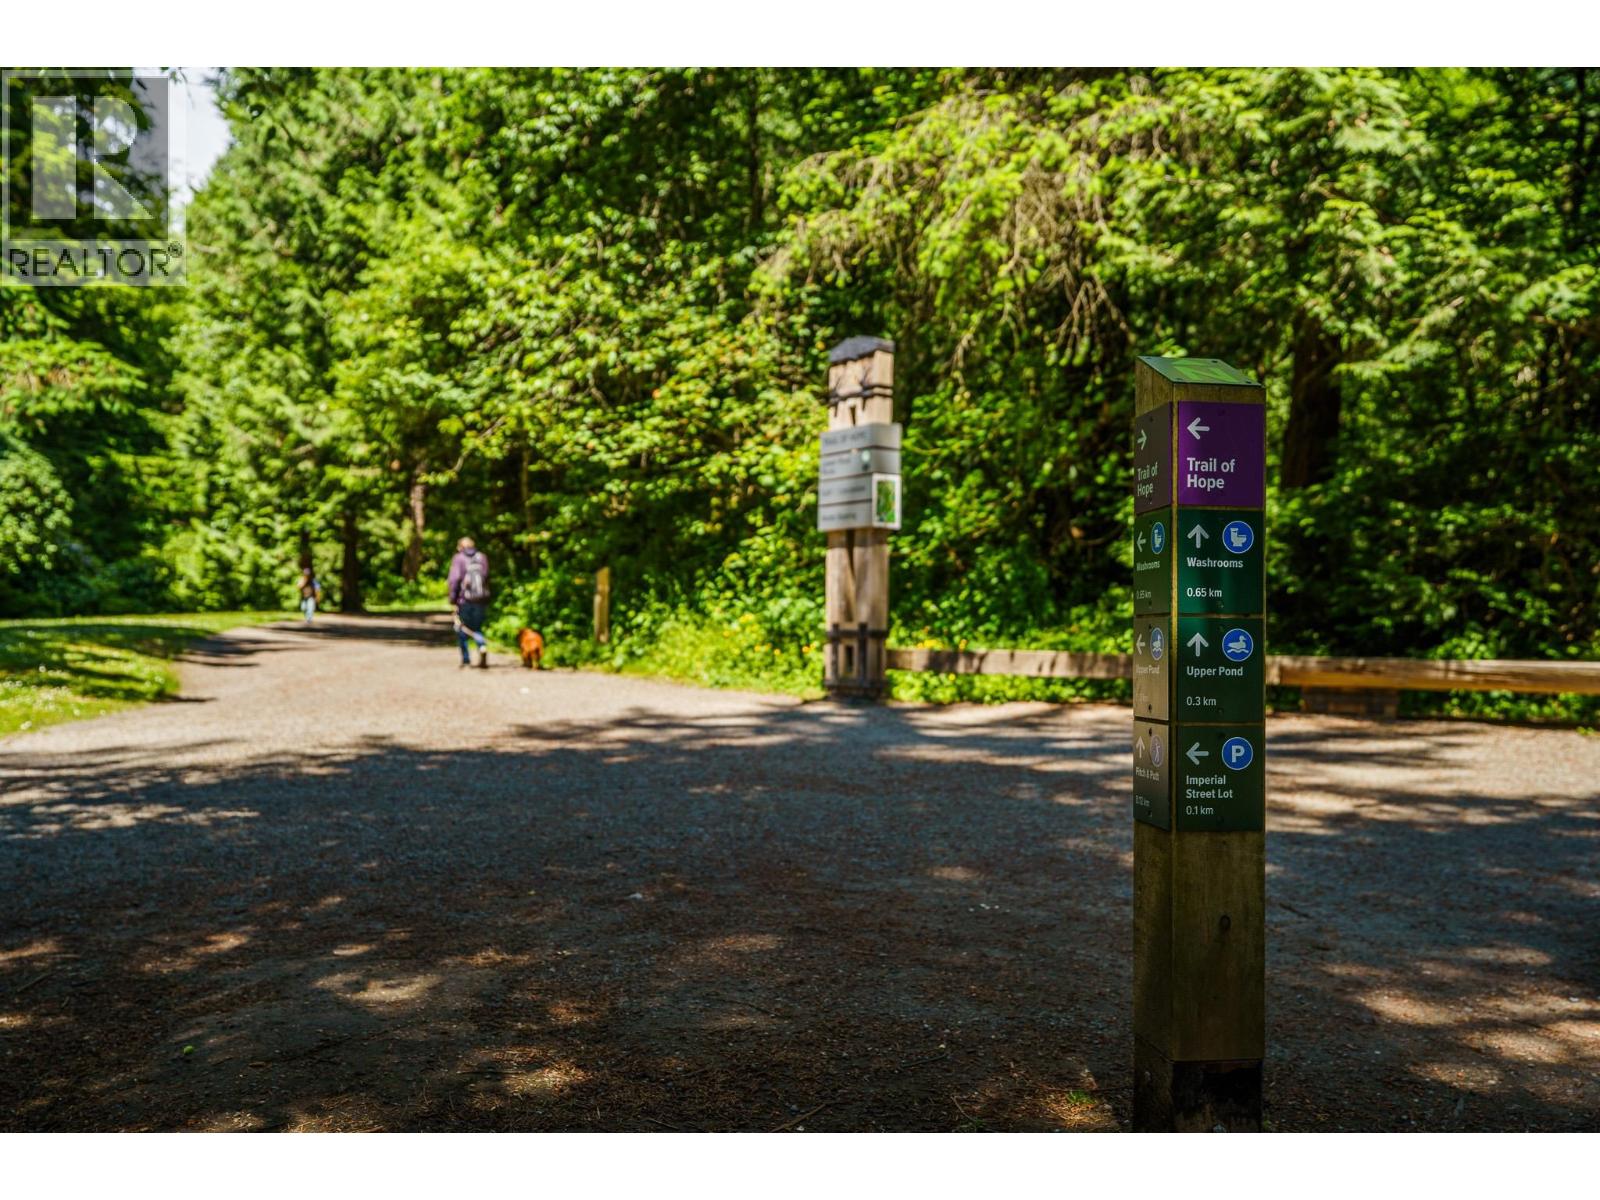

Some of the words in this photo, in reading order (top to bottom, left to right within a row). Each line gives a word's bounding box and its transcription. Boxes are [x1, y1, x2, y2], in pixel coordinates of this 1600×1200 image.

[1137, 464, 1150, 481] Trail
[1151, 461, 1158, 477] of
[1187, 457, 1217, 472] Trail
[1221, 459, 1236, 473] of
[1187, 474, 1225, 492] Hope
[1137, 482, 1154, 498] Hope
[1187, 557, 1244, 569] Washrooms
[1187, 587, 1207, 597] 0.65
[1209, 587, 1223, 598] km
[1186, 666, 1217, 678] Upper
[1218, 666, 1244, 676] Pond
[1186, 696, 1201, 706] 0.3
[1203, 696, 1217, 706] km
[1186, 774, 1226, 787] Imperial
[1186, 788, 1216, 799] Street
[1217, 788, 1234, 799] Lot
[1186, 805, 1198, 815] 0.1
[1200, 805, 1214, 815] km
